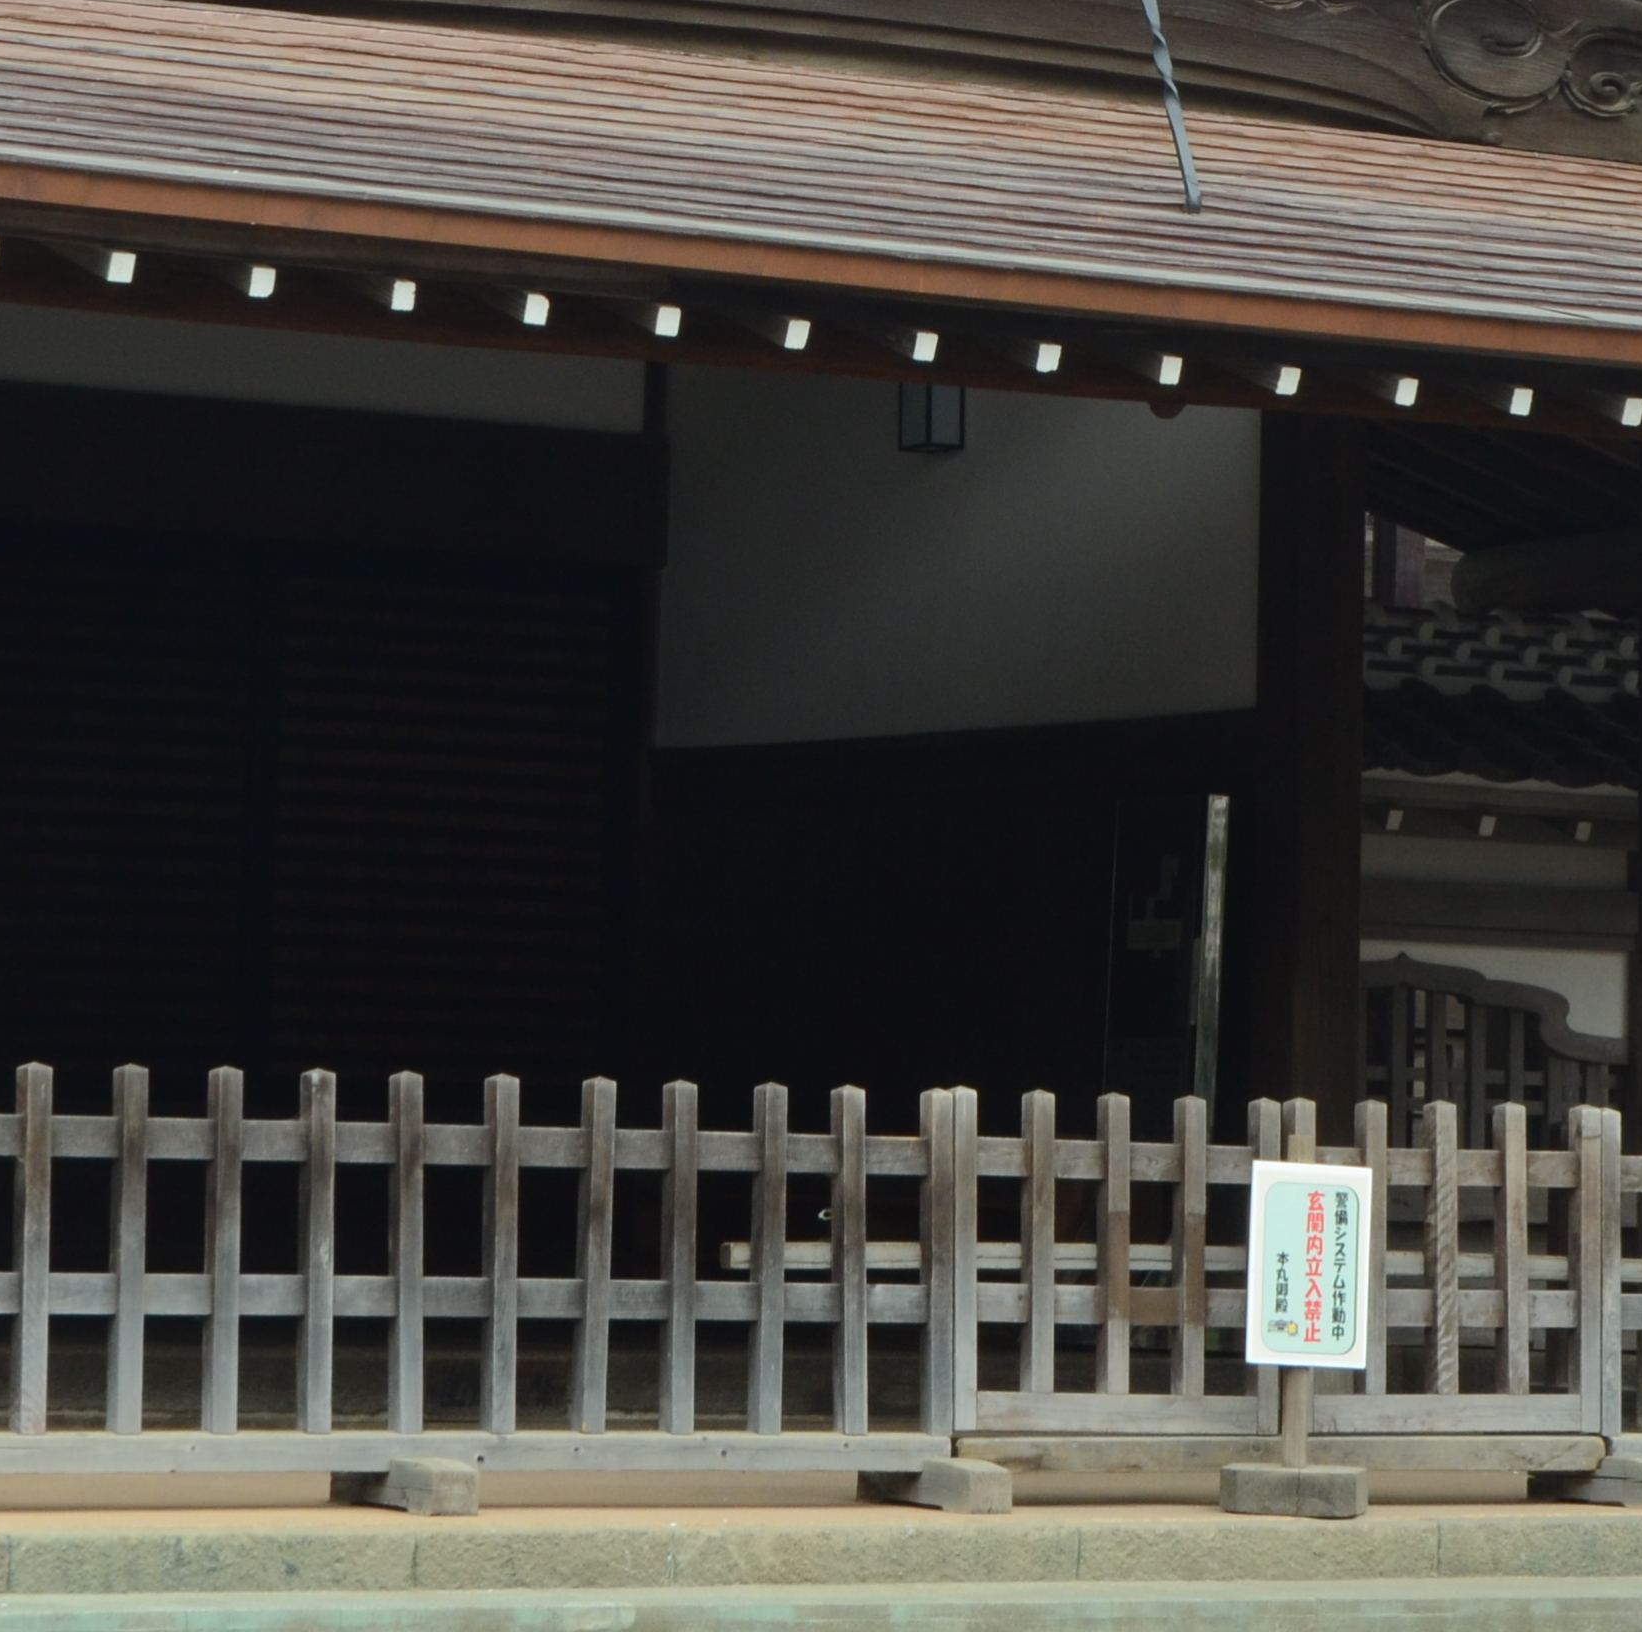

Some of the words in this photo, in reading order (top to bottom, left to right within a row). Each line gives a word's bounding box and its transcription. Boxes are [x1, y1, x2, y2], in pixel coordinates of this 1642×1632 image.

[1275, 1250, 1290, 1313] 本丸御殿
[1304, 1190, 1325, 1343] 玄関内立入禁止
[1332, 1191, 1349, 1342] 警備システム作動中
